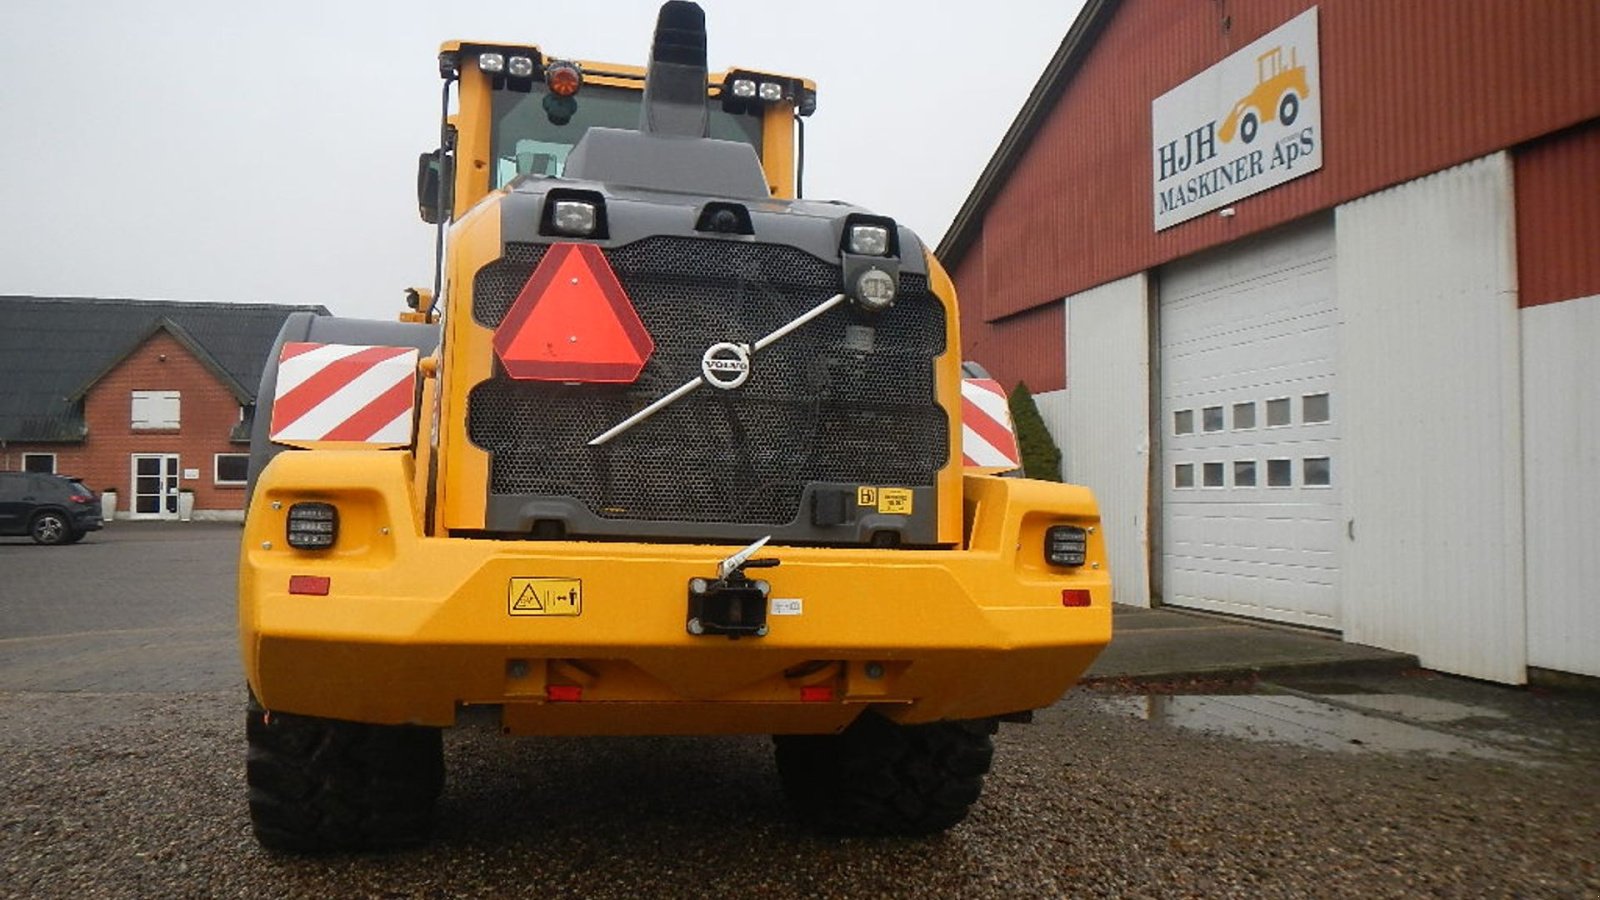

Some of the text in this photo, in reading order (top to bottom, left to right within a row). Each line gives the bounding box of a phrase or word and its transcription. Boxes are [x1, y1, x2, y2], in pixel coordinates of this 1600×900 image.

[1158, 120, 1217, 182] HJH
[1159, 127, 1314, 215] MASKINER ApS
[705, 360, 747, 370] VOLVO
